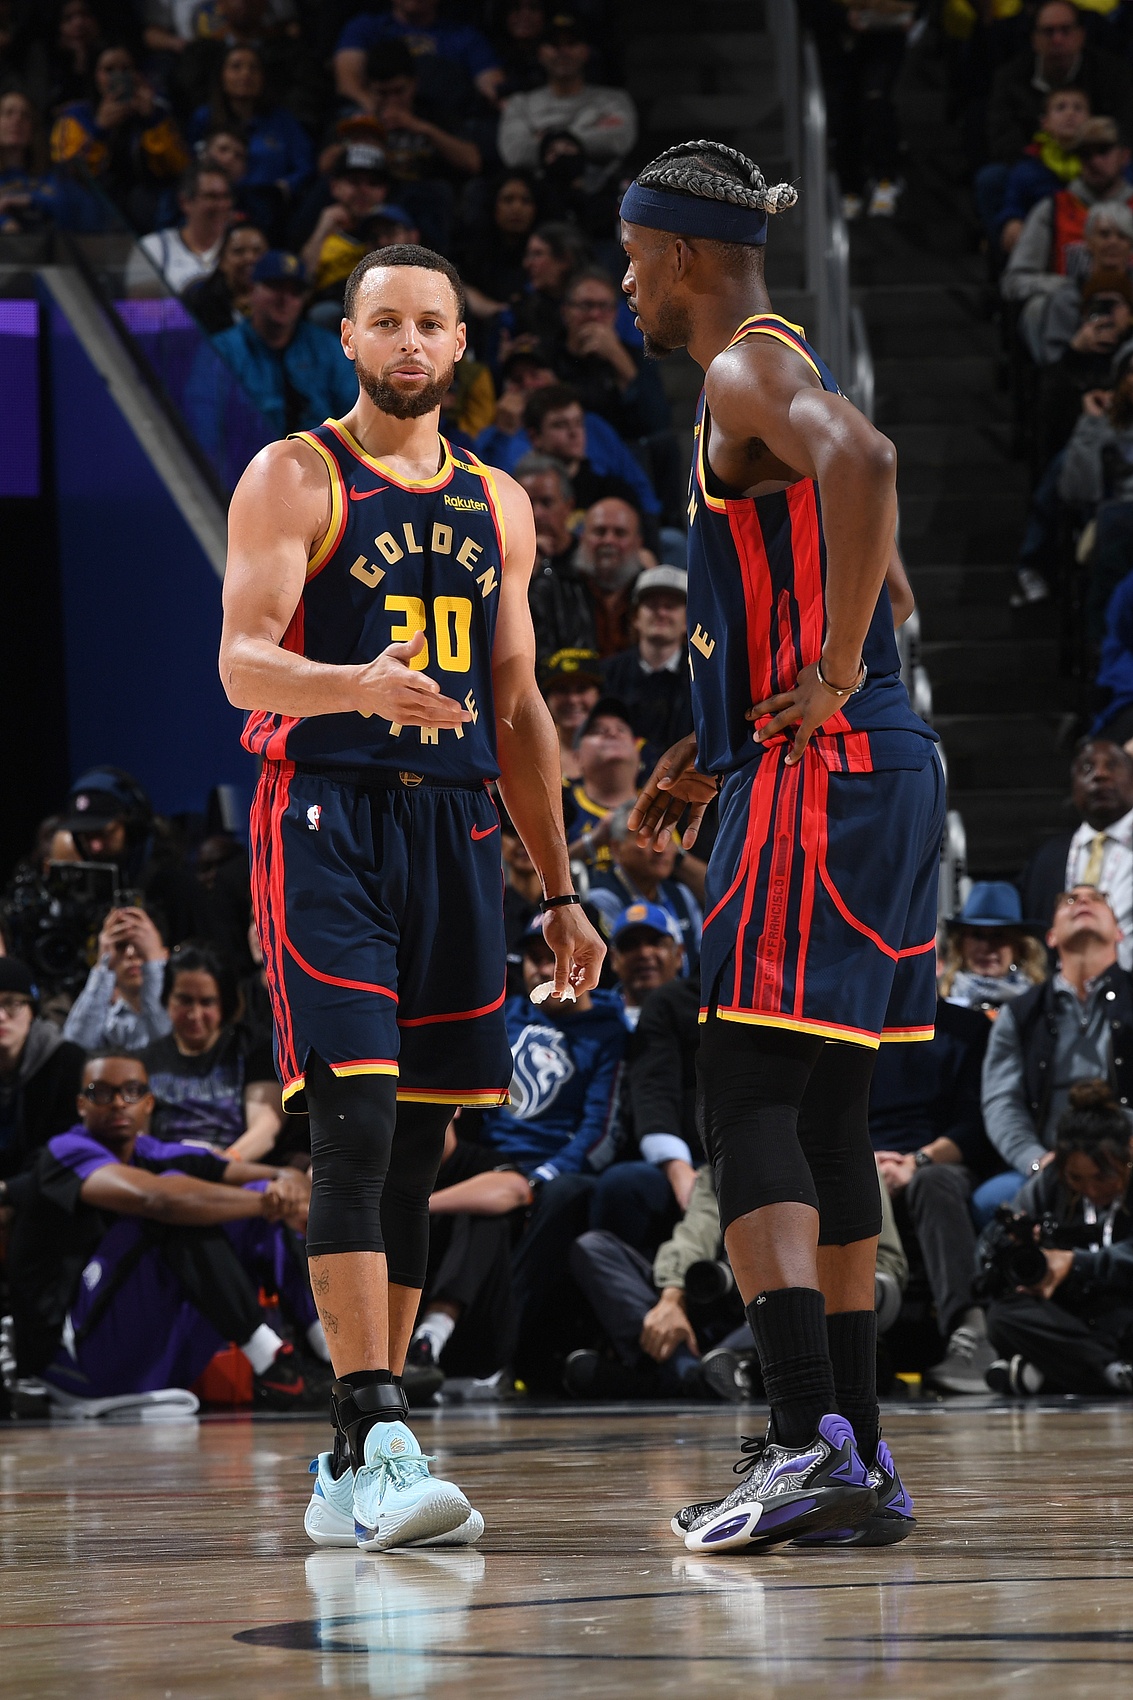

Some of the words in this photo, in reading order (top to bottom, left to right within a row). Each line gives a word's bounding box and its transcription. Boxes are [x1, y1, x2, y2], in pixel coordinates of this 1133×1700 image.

[443, 494, 489, 512] Rakuten
[349, 522, 498, 598] GOLDEN
[384, 595, 473, 673] 30
[766, 879, 785, 948] FRANCISCO
